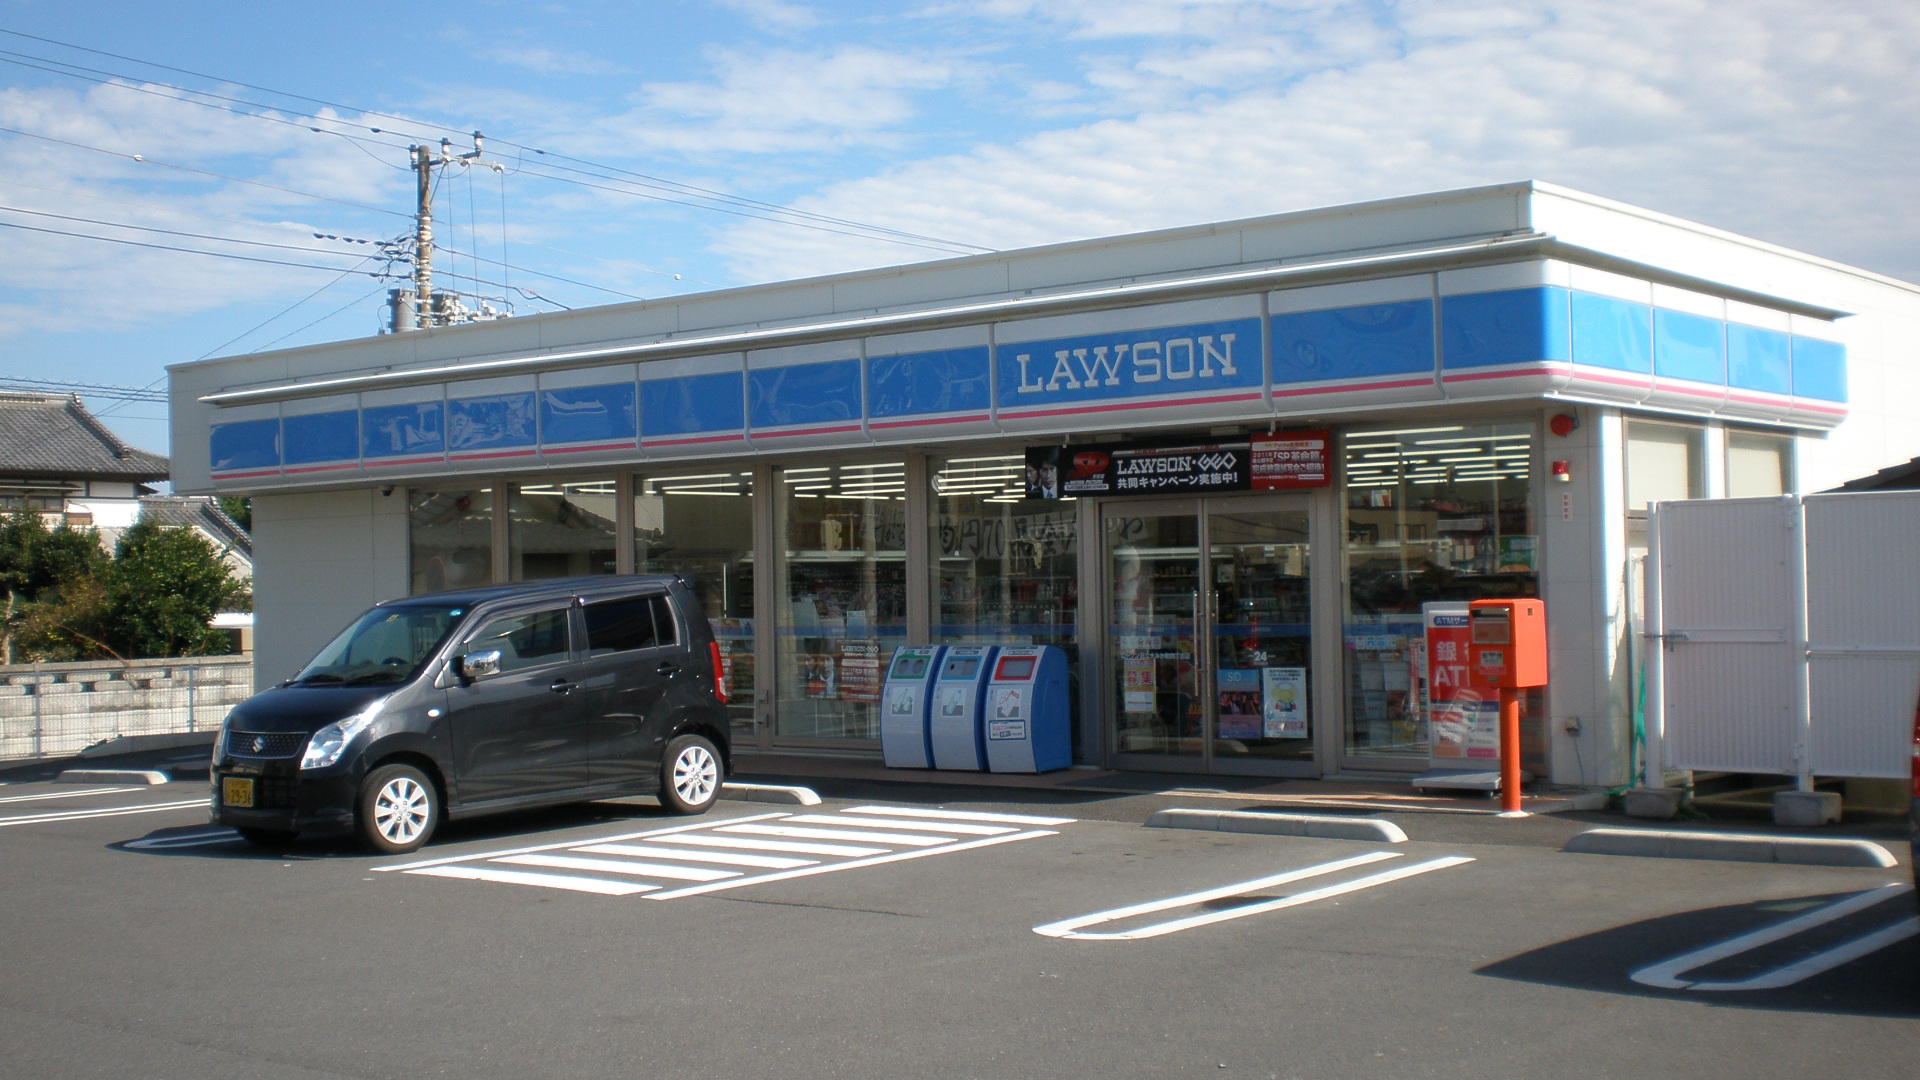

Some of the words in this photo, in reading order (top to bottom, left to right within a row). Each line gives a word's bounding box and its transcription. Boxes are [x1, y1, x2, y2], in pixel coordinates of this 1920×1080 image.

[1017, 333, 1237, 393] LAWSON
[1254, 651, 1268, 662] 24
[1434, 665, 1469, 687] AT
